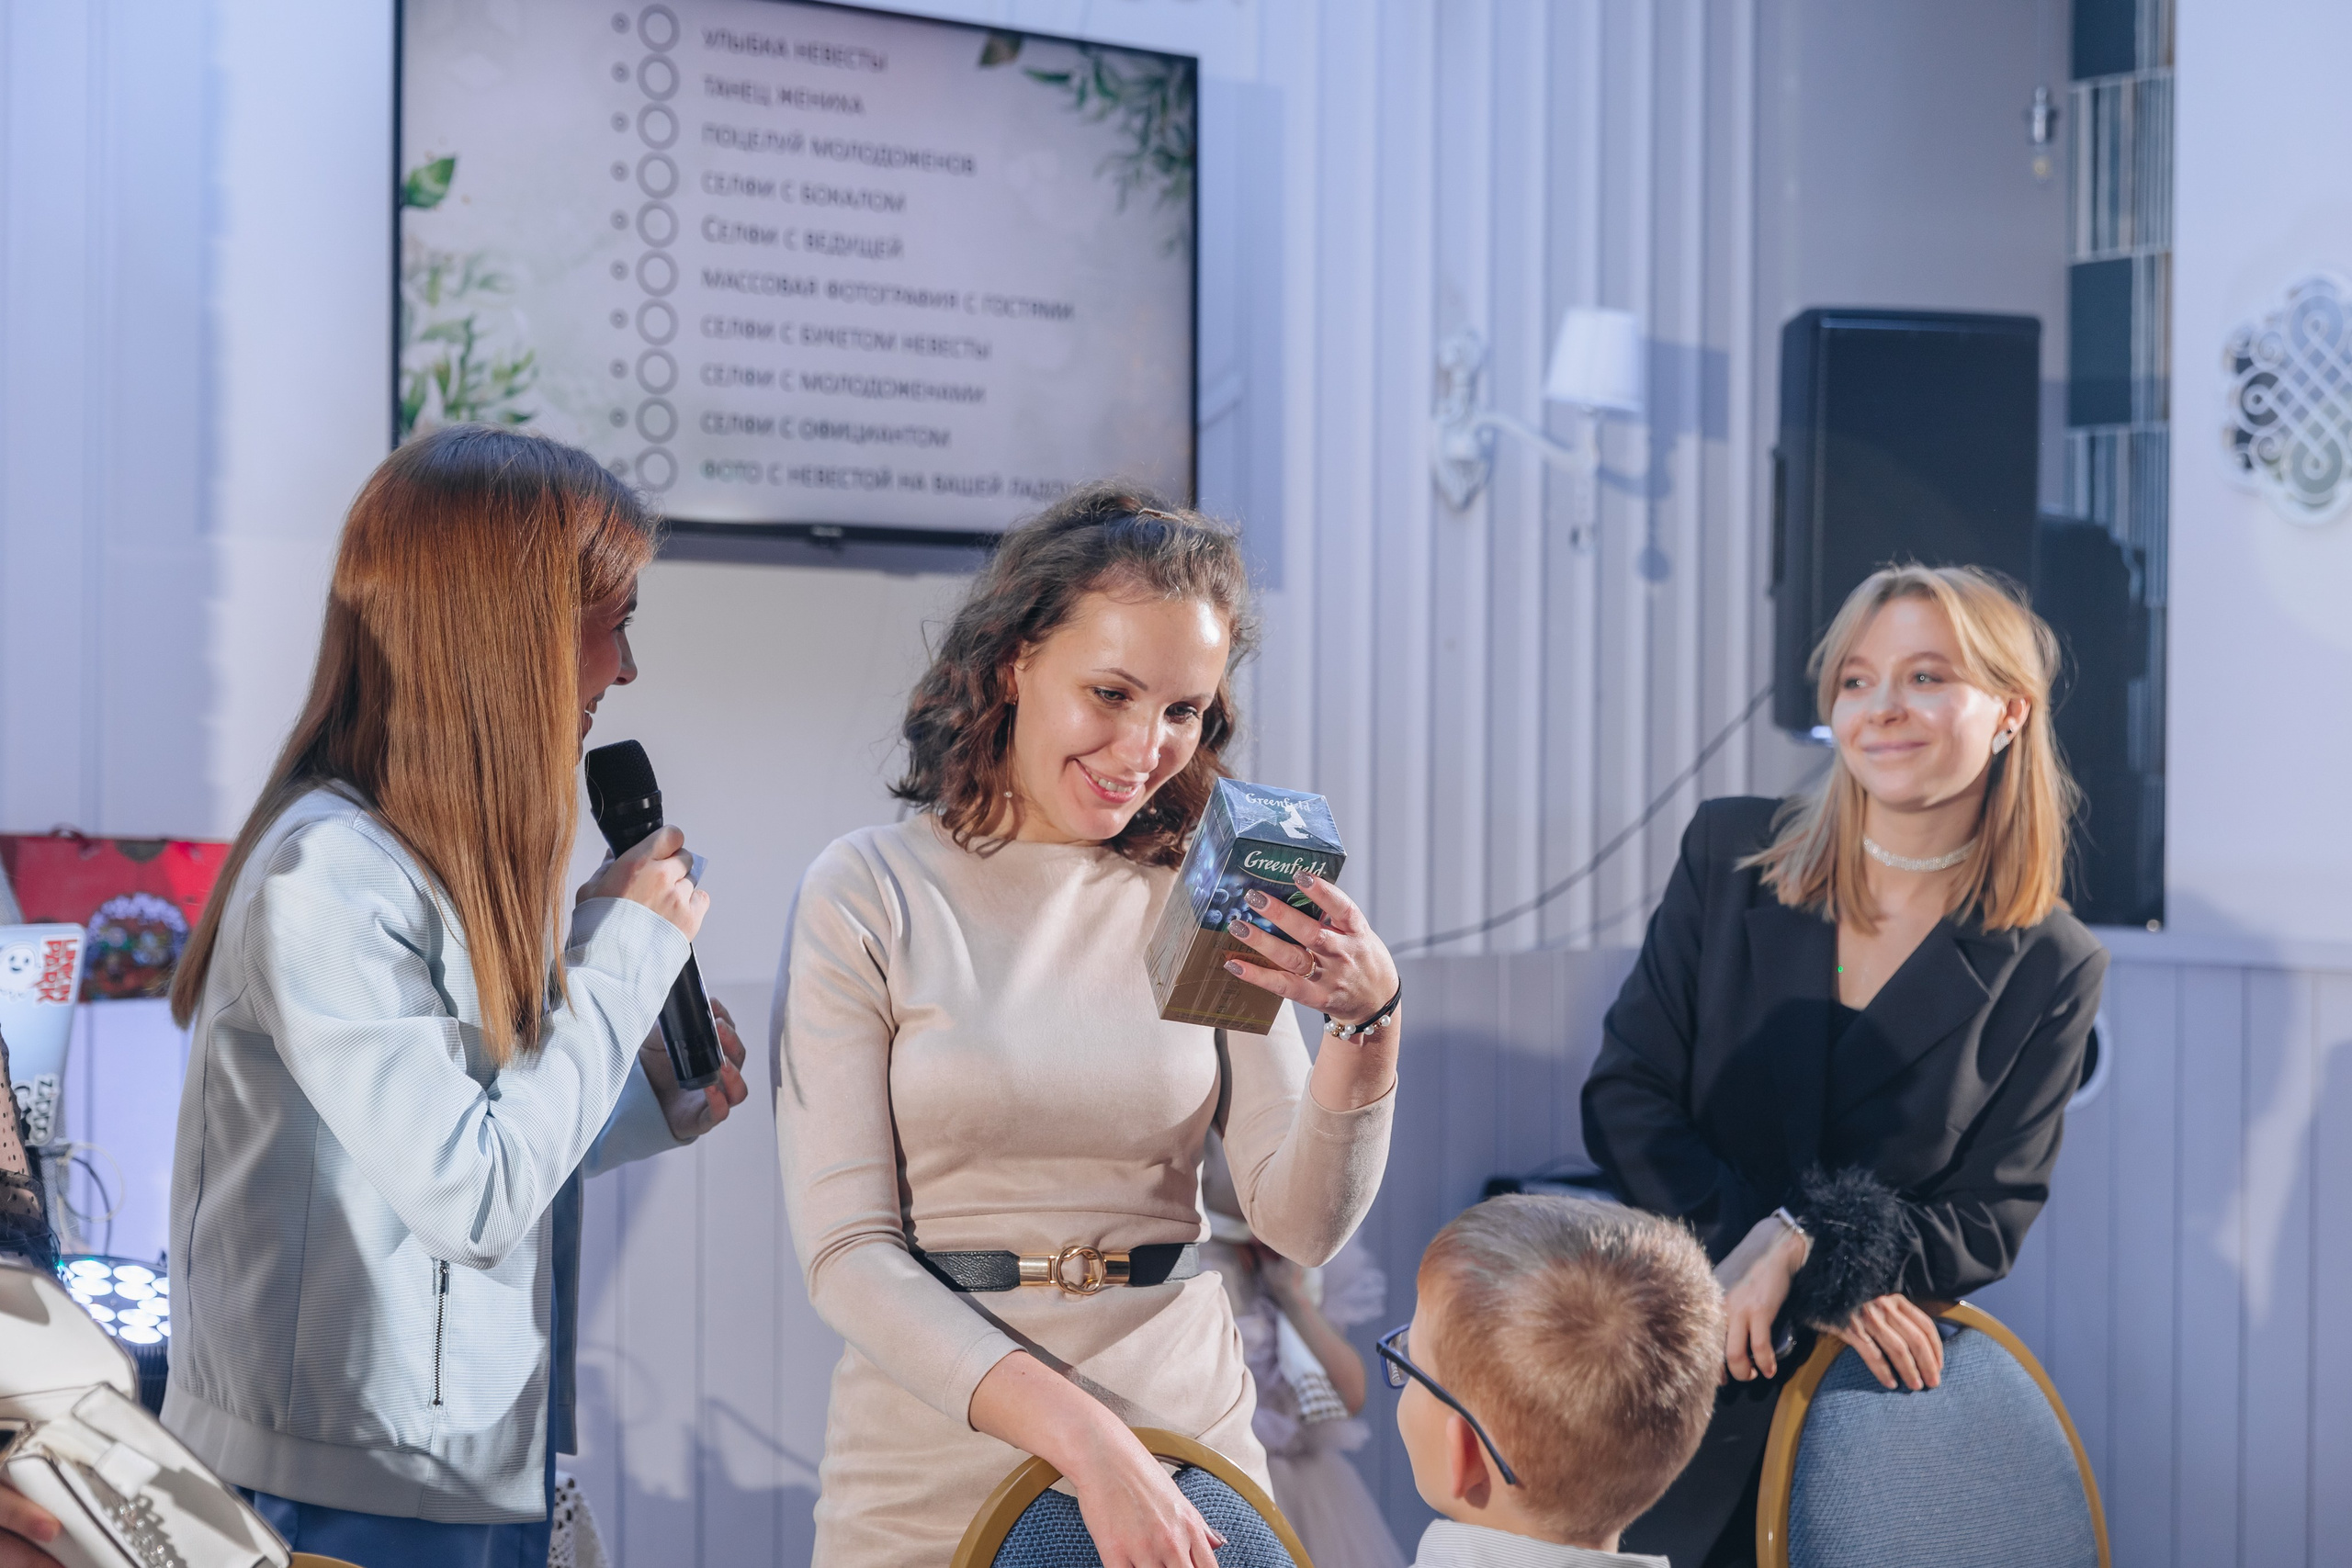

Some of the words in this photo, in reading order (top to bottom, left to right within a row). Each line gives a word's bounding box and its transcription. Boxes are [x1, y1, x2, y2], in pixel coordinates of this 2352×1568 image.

[701, 26, 788, 59] УЛЫБКА
[794, 41, 888, 73] НЕВЕСТЫ
[703, 73, 772, 107] ТАНЕЦ
[776, 85, 865, 116] ЖЕНИХА
[702, 120, 805, 154] ПОЦЕЛУЙ
[810, 136, 976, 175] МОЛОДОЖЕНОВ
[701, 170, 777, 200] СЕЛФИ
[780, 178, 796, 204] С
[800, 181, 907, 213] БОКАЛОМ
[783, 225, 798, 252] С
[803, 226, 904, 260] ВЕДУЩЕЙ
[702, 267, 818, 299] МАССОВАЯ
[826, 279, 956, 310] ФОТОГРАФИЯ
[963, 291, 979, 315] С
[981, 292, 1076, 321] ГОСТЯМИ
[700, 313, 775, 342] СЕЛФИ
[779, 320, 795, 345] С
[800, 321, 897, 354] БУКЕТОМ
[900, 333, 992, 360] НЕВЕСТЫ
[700, 362, 775, 389] СЕЛФИ
[779, 367, 795, 393] С
[800, 369, 987, 405] МОЛОДОЖЕНАМИ
[699, 410, 775, 438] СЕЛФИ
[778, 414, 795, 440] С
[798, 415, 952, 449] ОФИЦИАНТОМ
[699, 458, 763, 485] ФОТО
[766, 461, 783, 487] С
[787, 462, 892, 491] НЕВЕСТОЙ
[897, 472, 927, 493] НА
[933, 471, 1003, 498] ВАШЕЙ
[1245, 793, 1311, 812] Greenfield
[1244, 850, 1327, 878] Greenfield
[34, 941, 62, 1002] PARK
